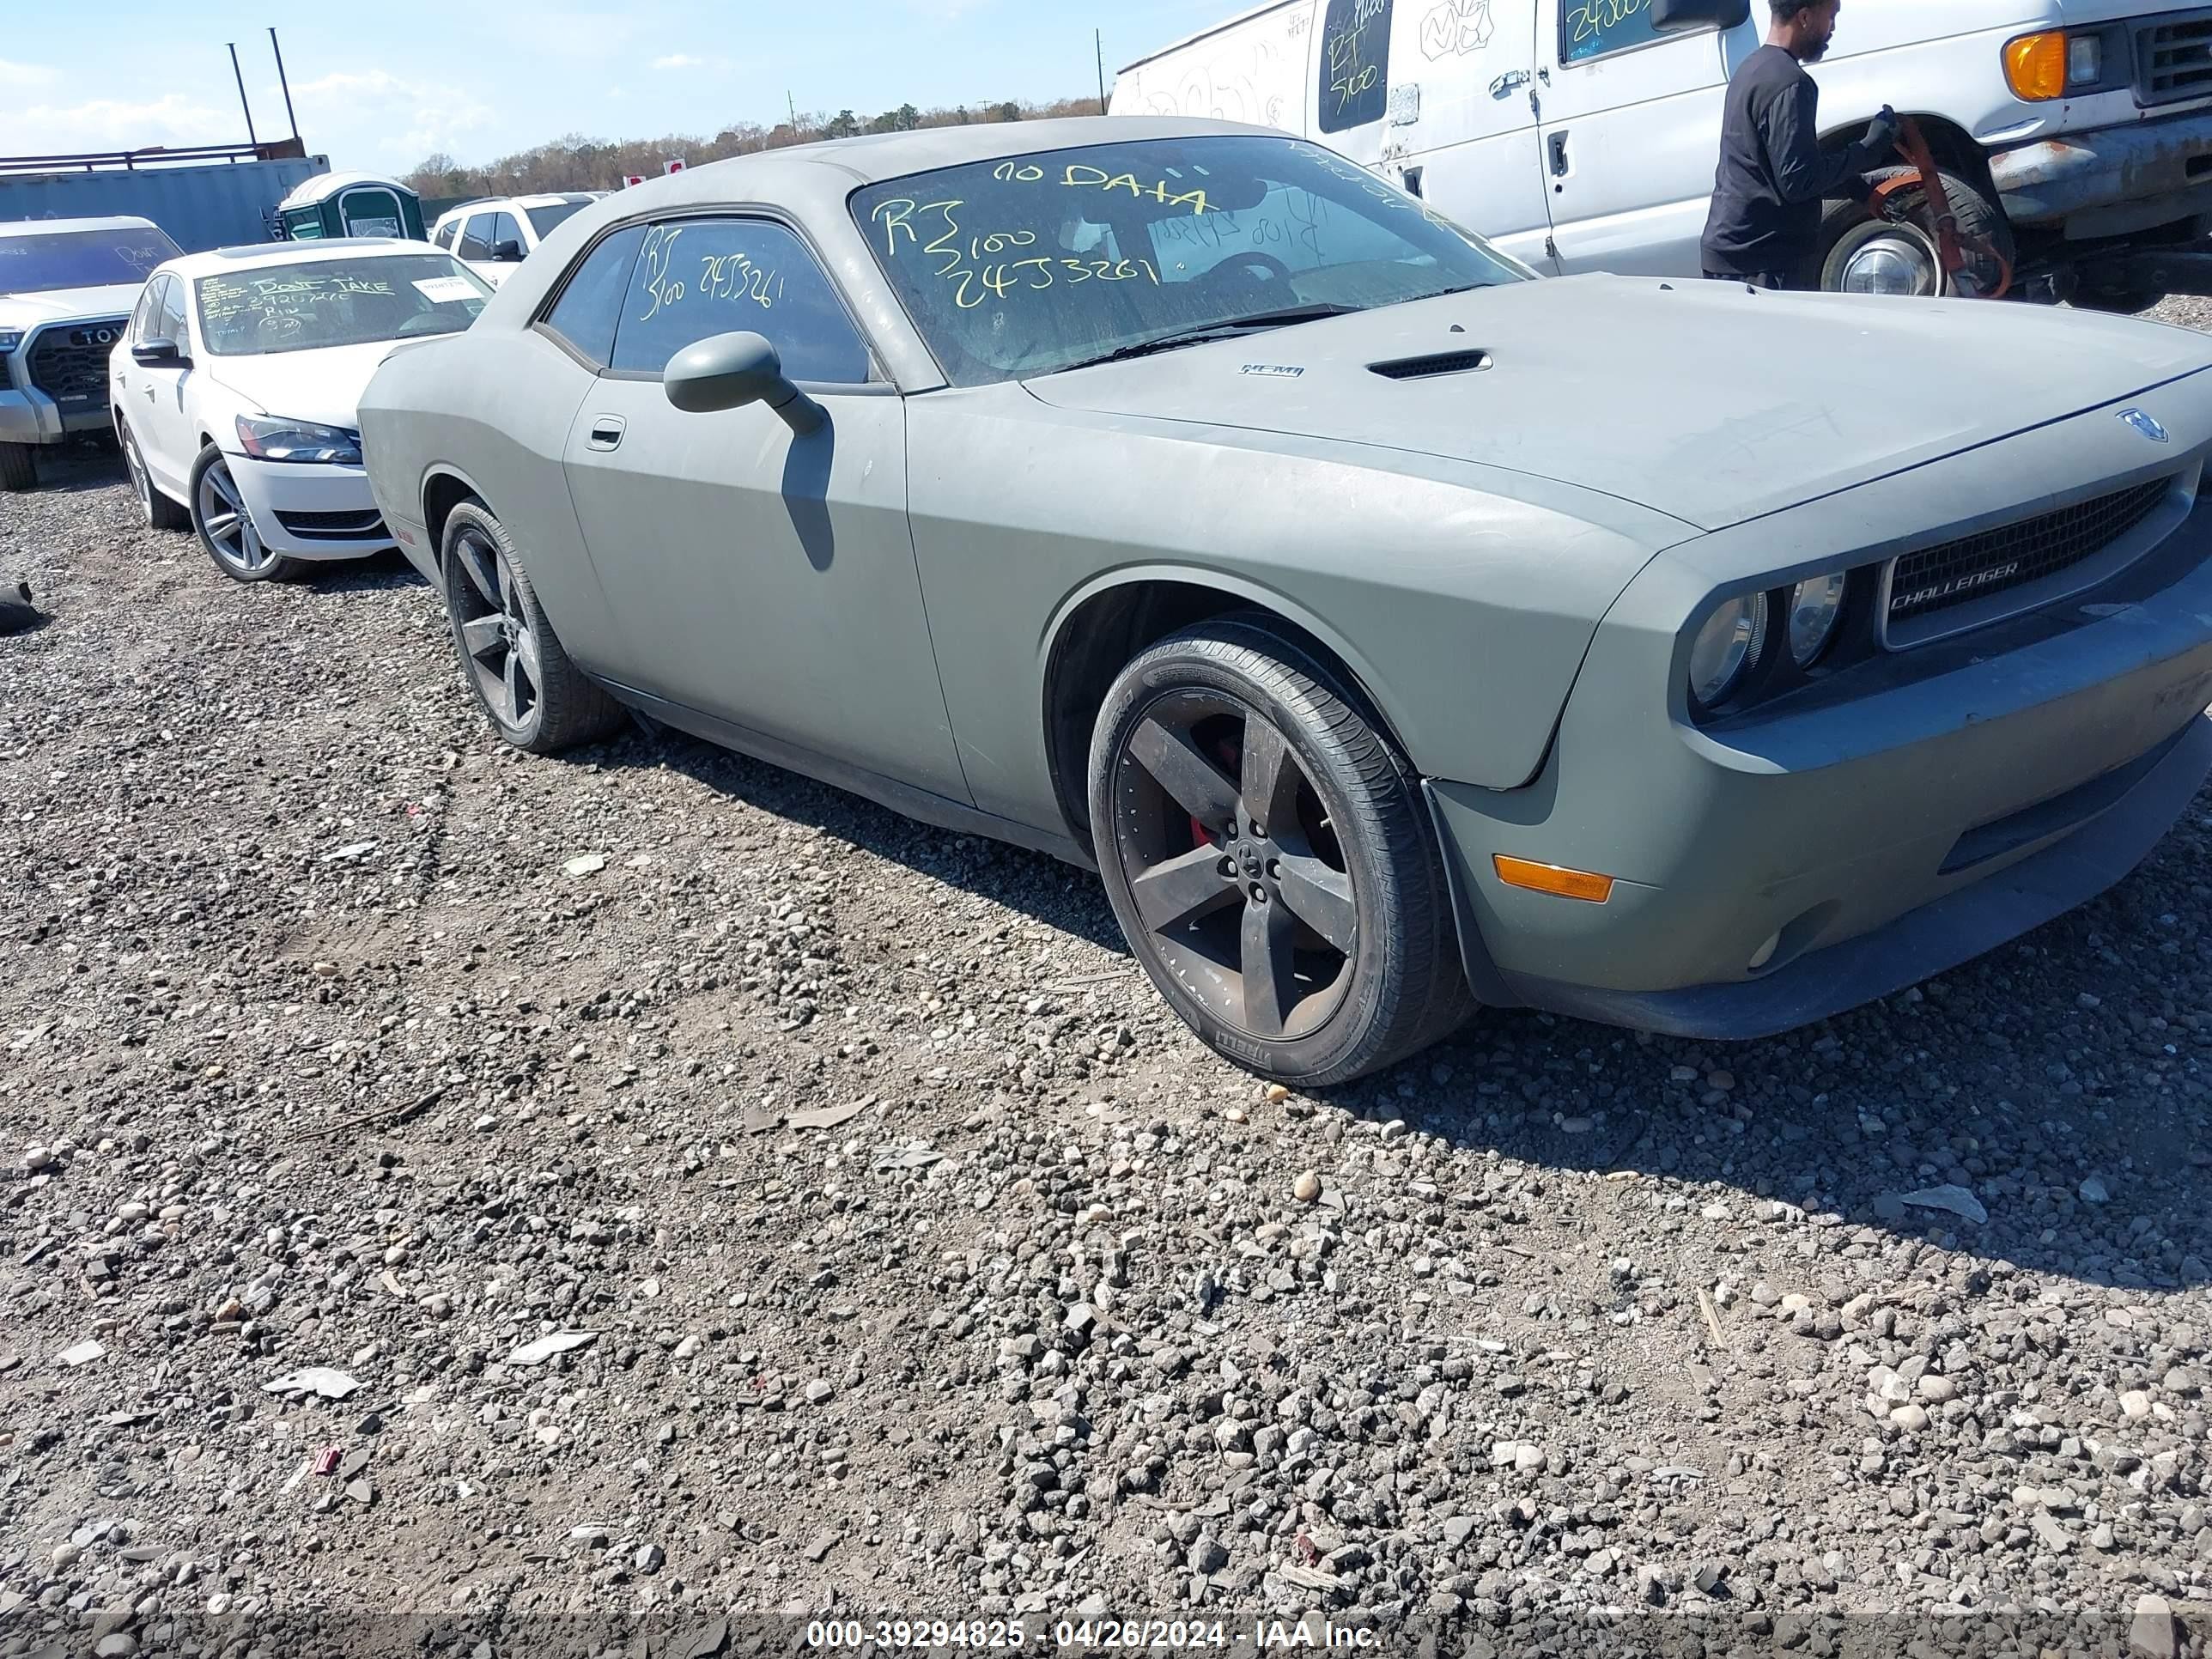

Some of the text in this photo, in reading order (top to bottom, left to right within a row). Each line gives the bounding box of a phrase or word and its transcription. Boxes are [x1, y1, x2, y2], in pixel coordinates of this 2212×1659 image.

[330, 276, 395, 295] TAKE
[1237, 364, 1305, 378] HEMI
[1890, 562, 2020, 611] CHALLENGER
